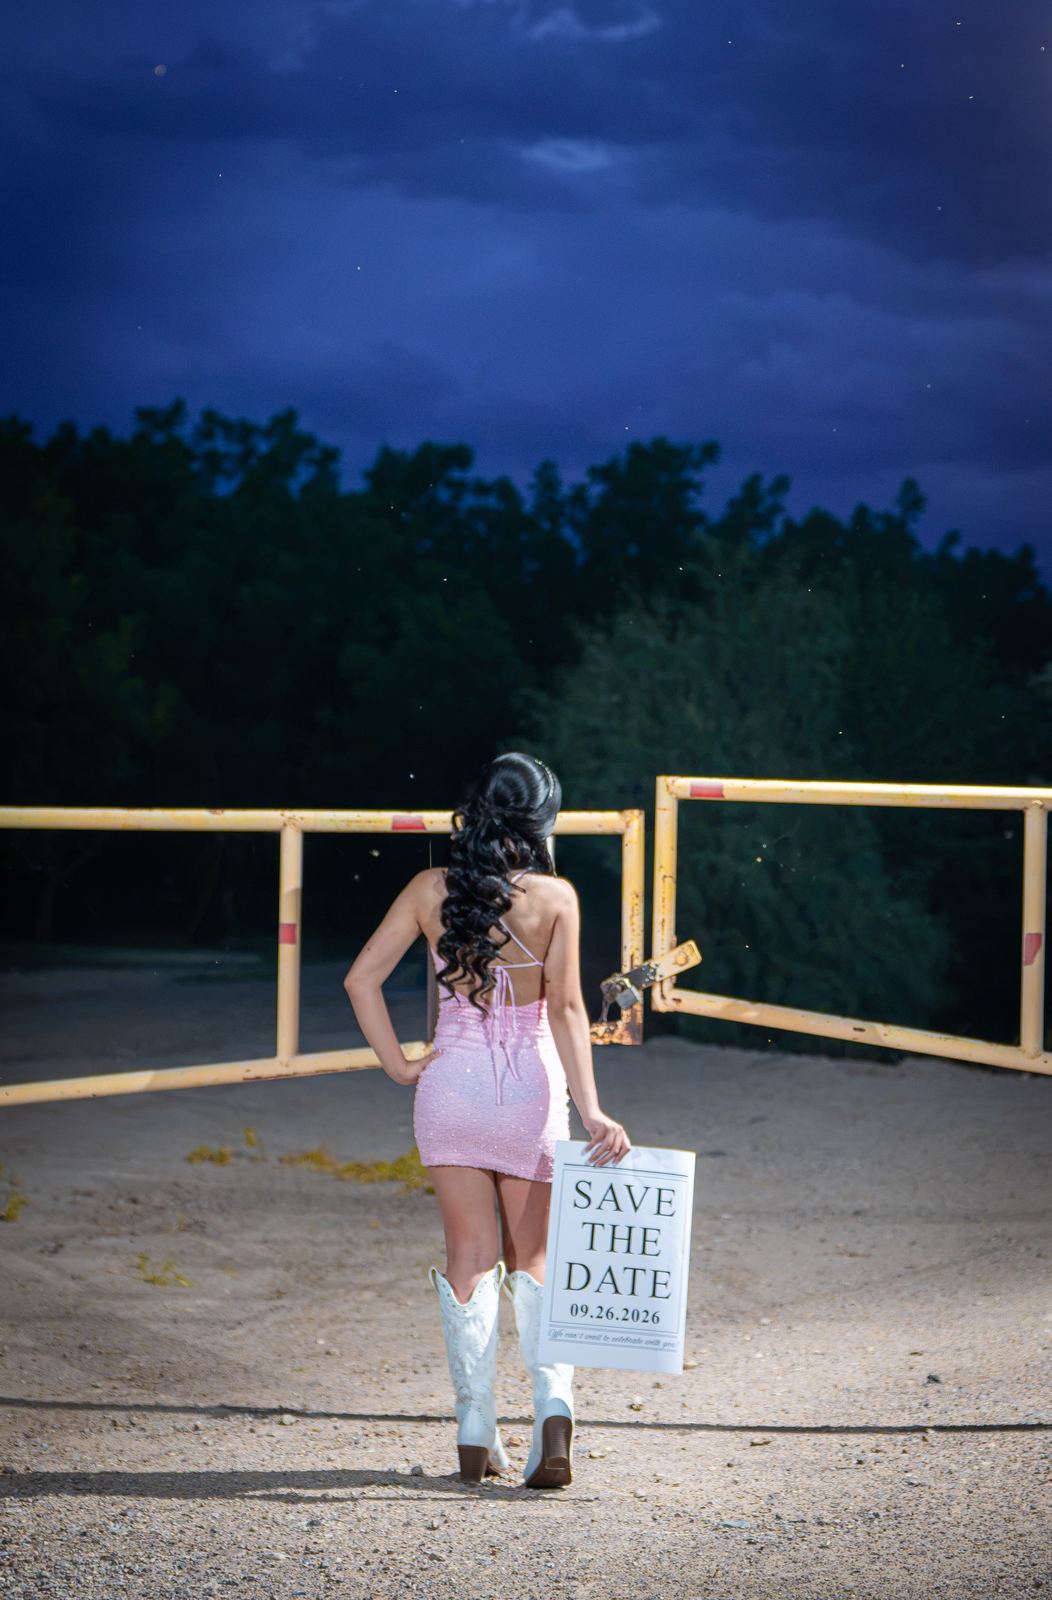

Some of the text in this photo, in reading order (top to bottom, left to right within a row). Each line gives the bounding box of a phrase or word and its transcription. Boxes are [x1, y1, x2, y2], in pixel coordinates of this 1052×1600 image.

[573, 1180, 676, 1217] SAVE
[581, 1222, 661, 1257] THE
[563, 1262, 672, 1299] DATE
[570, 1303, 660, 1325] 09.26.2026
